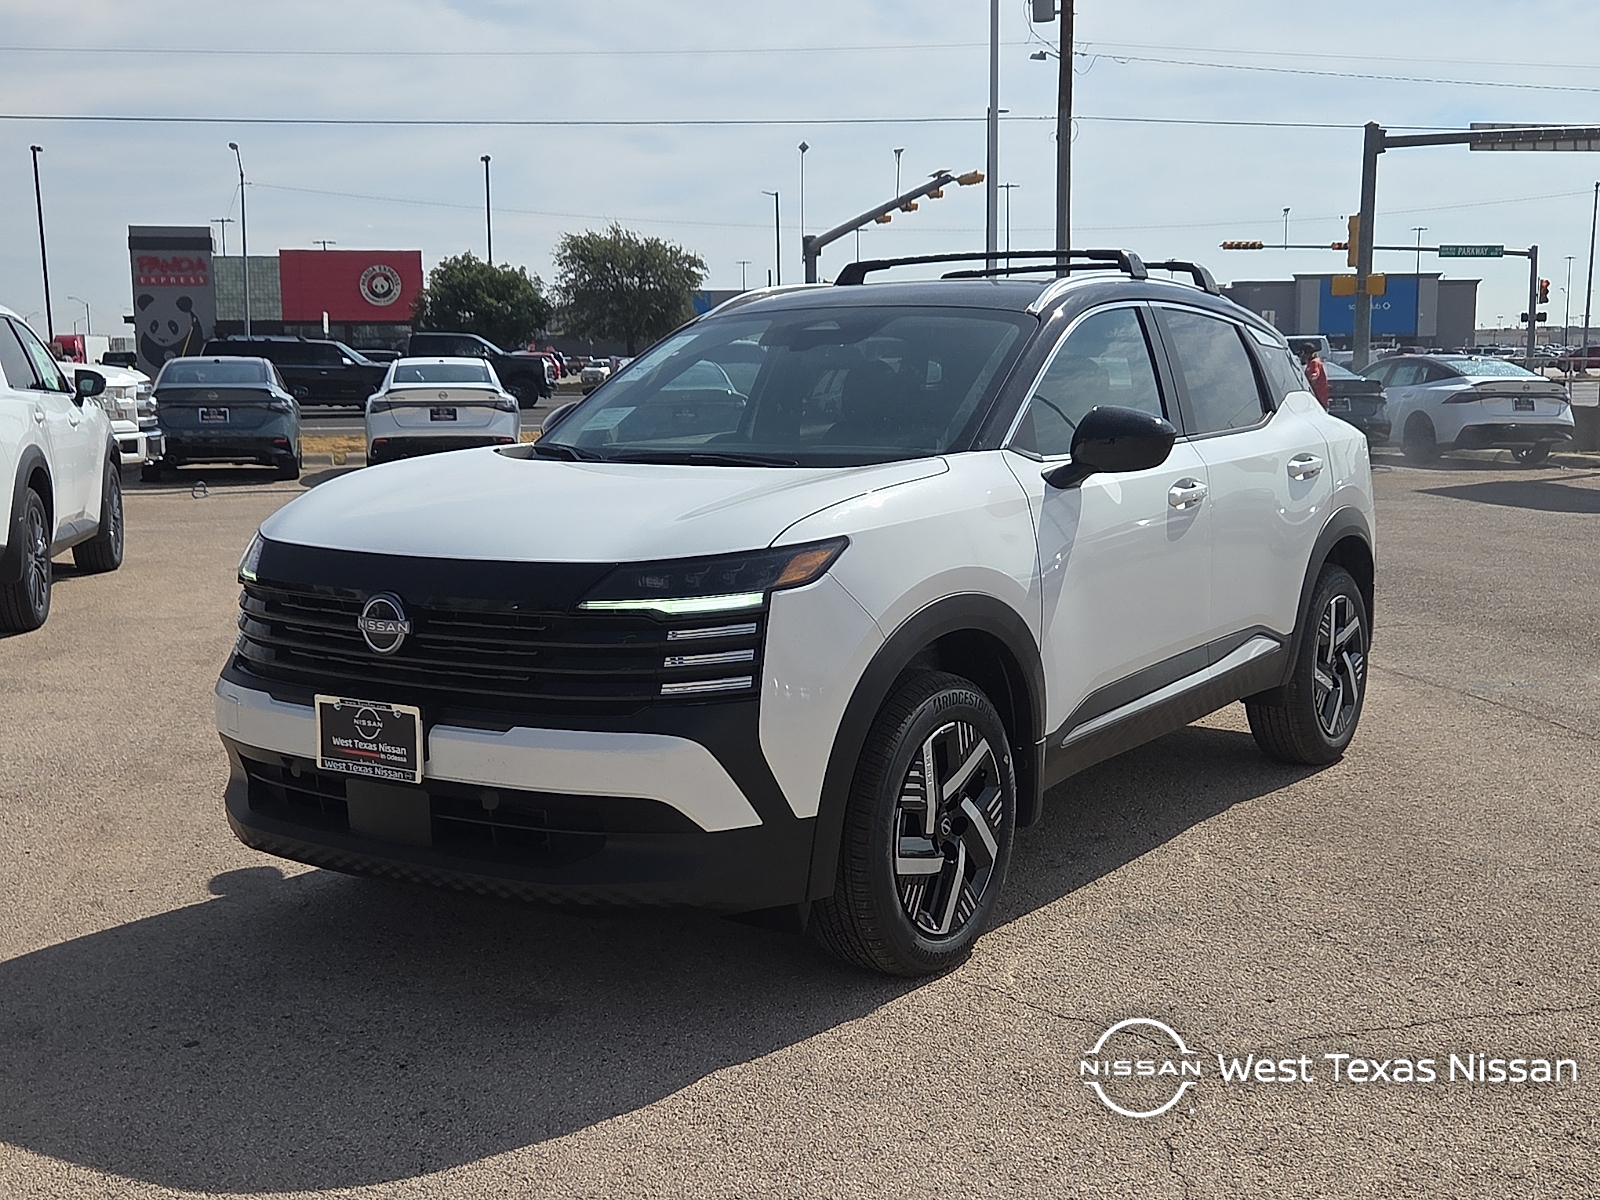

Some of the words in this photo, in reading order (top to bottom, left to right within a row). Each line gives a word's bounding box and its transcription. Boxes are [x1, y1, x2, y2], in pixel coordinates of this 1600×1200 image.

[1458, 246, 1489, 256] PARKWAY
[136, 255, 208, 274] PANDA
[140, 276, 205, 284] EXPRESS
[358, 616, 408, 632] NISSAN
[932, 691, 993, 720] BRIDGESTONE
[353, 718, 383, 728] NISSAN
[332, 736, 353, 747] West
[354, 739, 378, 751] Texas
[378, 743, 407, 755] Nissan
[324, 760, 347, 769] West
[347, 763, 373, 774] Texas
[374, 767, 404, 779] Nissan
